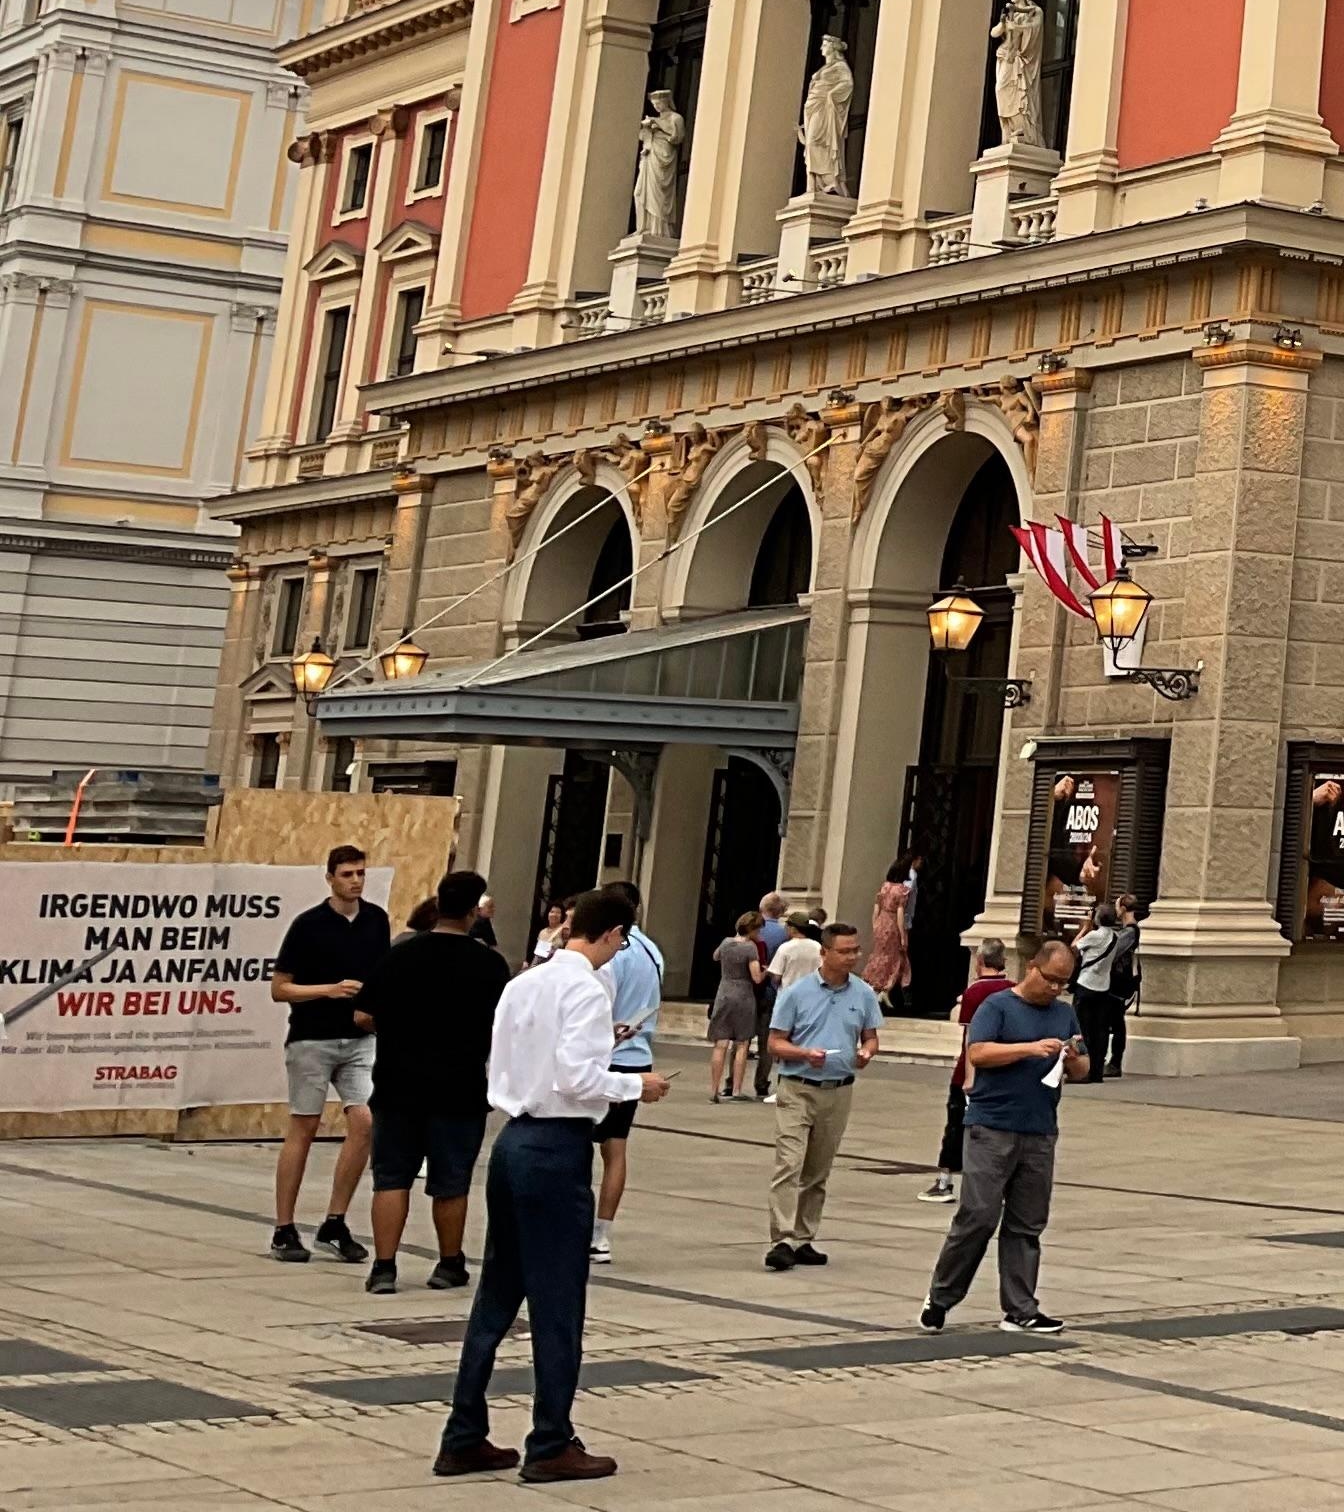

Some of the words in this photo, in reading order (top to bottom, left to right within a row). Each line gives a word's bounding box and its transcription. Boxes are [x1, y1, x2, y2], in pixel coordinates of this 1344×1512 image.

[1066, 805, 1099, 831] ABOS
[39, 893, 198, 919] IRGENDWO
[204, 894, 281, 919] MUSS
[84, 926, 153, 951] MAN
[160, 926, 231, 950] BEIM
[0, 958, 94, 984] KLIMA
[101, 959, 136, 983] JA
[143, 958, 279, 983] ANFANGE
[57, 991, 116, 1017] WIR
[122, 991, 171, 1016] BEI
[177, 990, 242, 1016] UNS.
[94, 1065, 178, 1081] STRABAG
